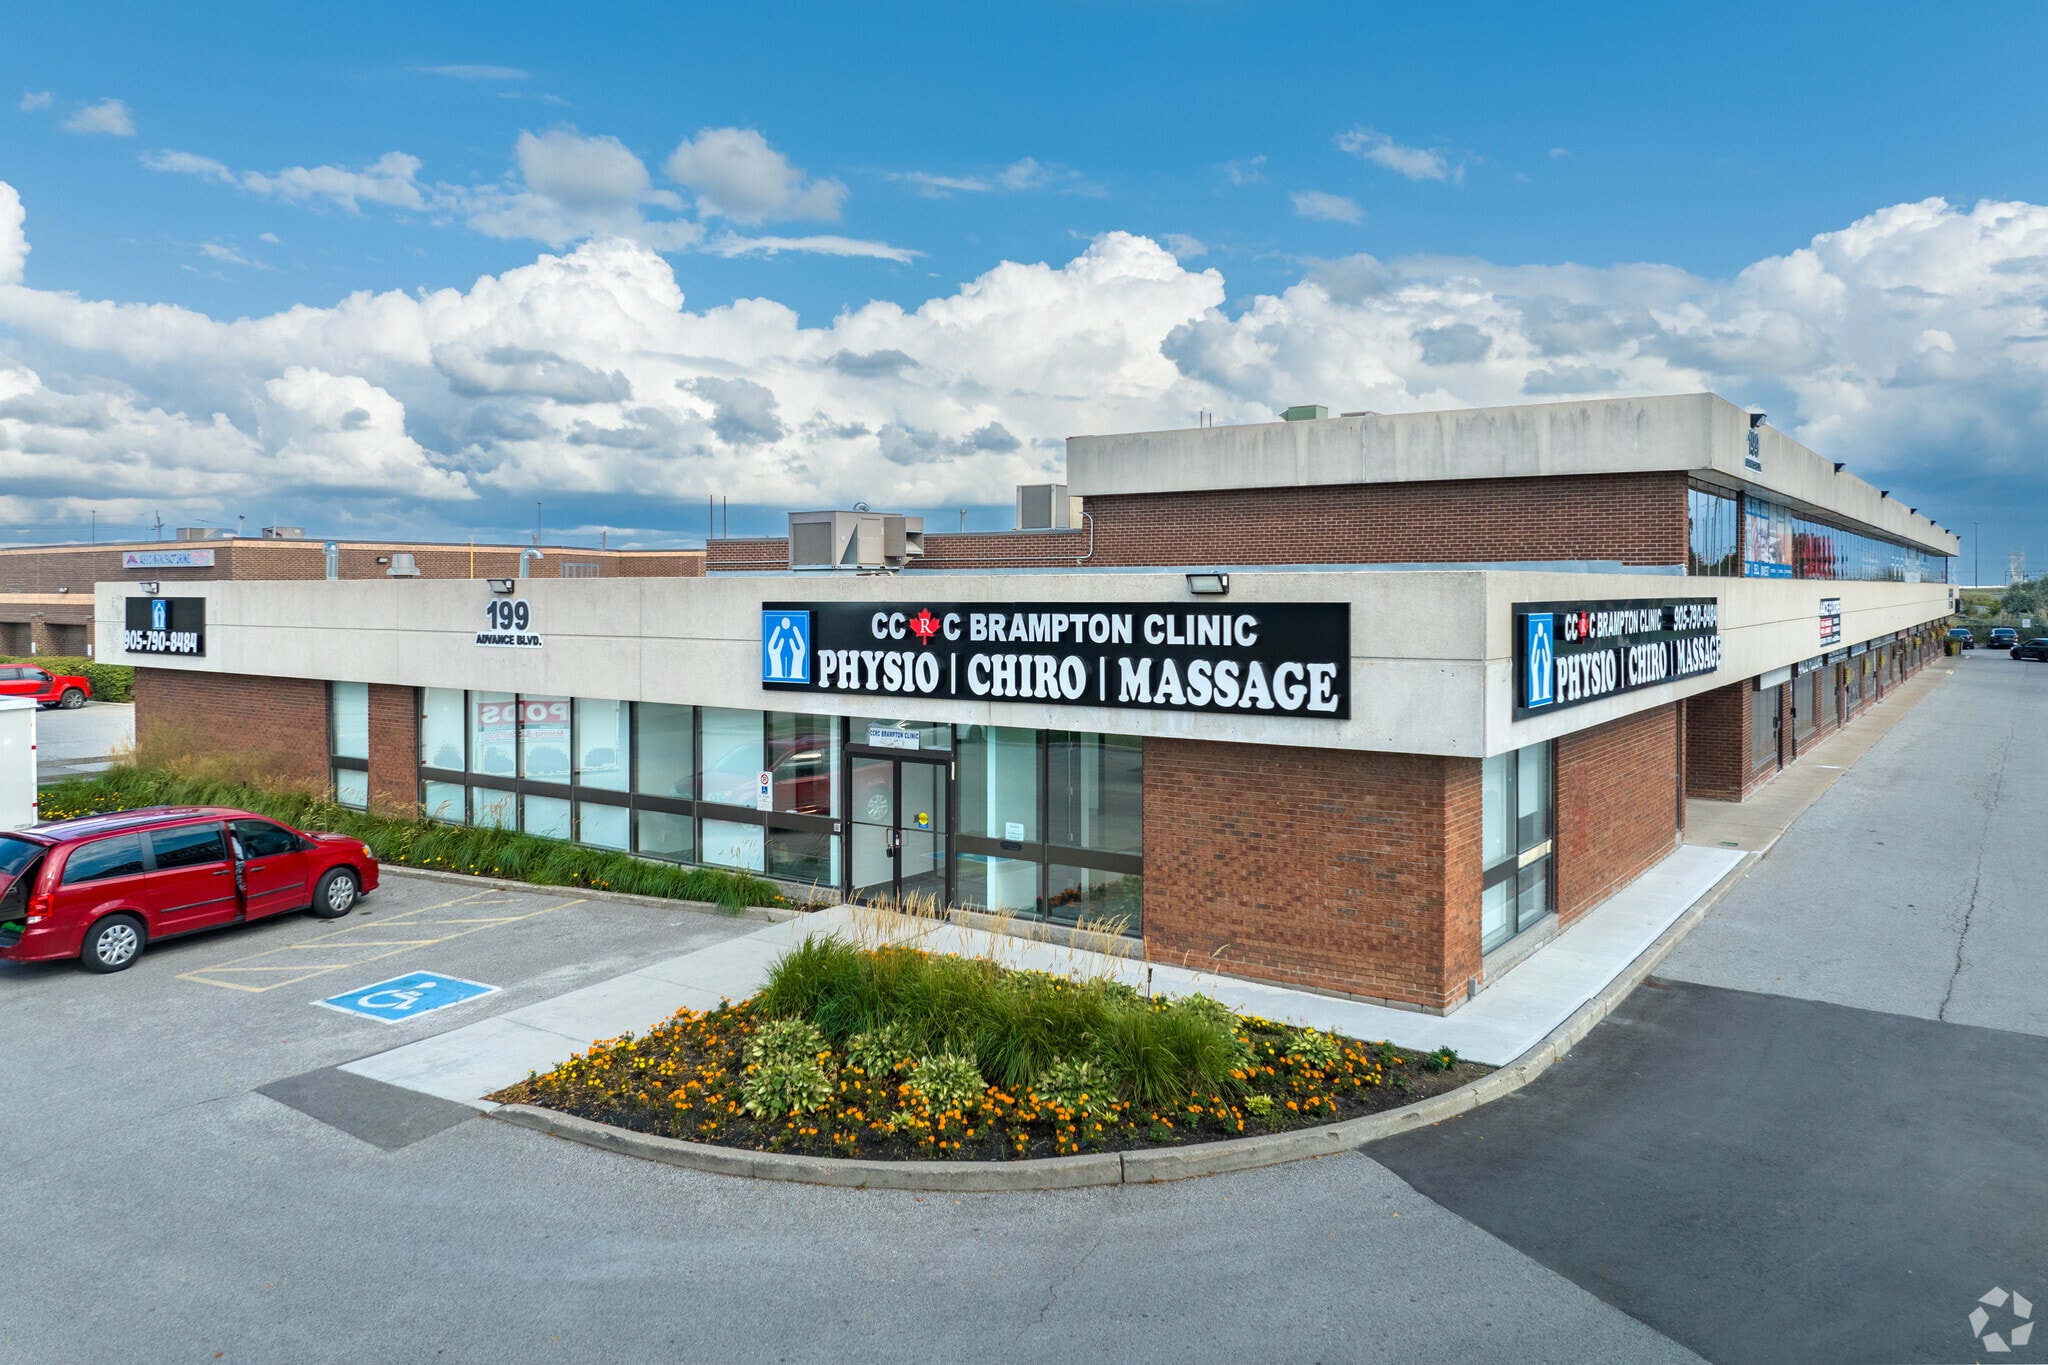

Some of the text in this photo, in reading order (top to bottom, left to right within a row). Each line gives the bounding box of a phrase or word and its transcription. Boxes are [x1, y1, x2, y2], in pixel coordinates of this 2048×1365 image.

[487, 600, 529, 630] 199
[970, 613, 1132, 644] BRAMPTON
[1144, 614, 1258, 646] CLINIC
[1597, 610, 1639, 637] BRAMPTON
[1640, 608, 1662, 633] CLINIC
[125, 630, 197, 653] 905-790-8484
[476, 634, 542, 646] ADVANCE BLVD.
[818, 650, 1338, 712] PHYSIO CHIRO MASSAGE
[1556, 635, 1721, 703] PHYSIO CHIRO MASSAGE
